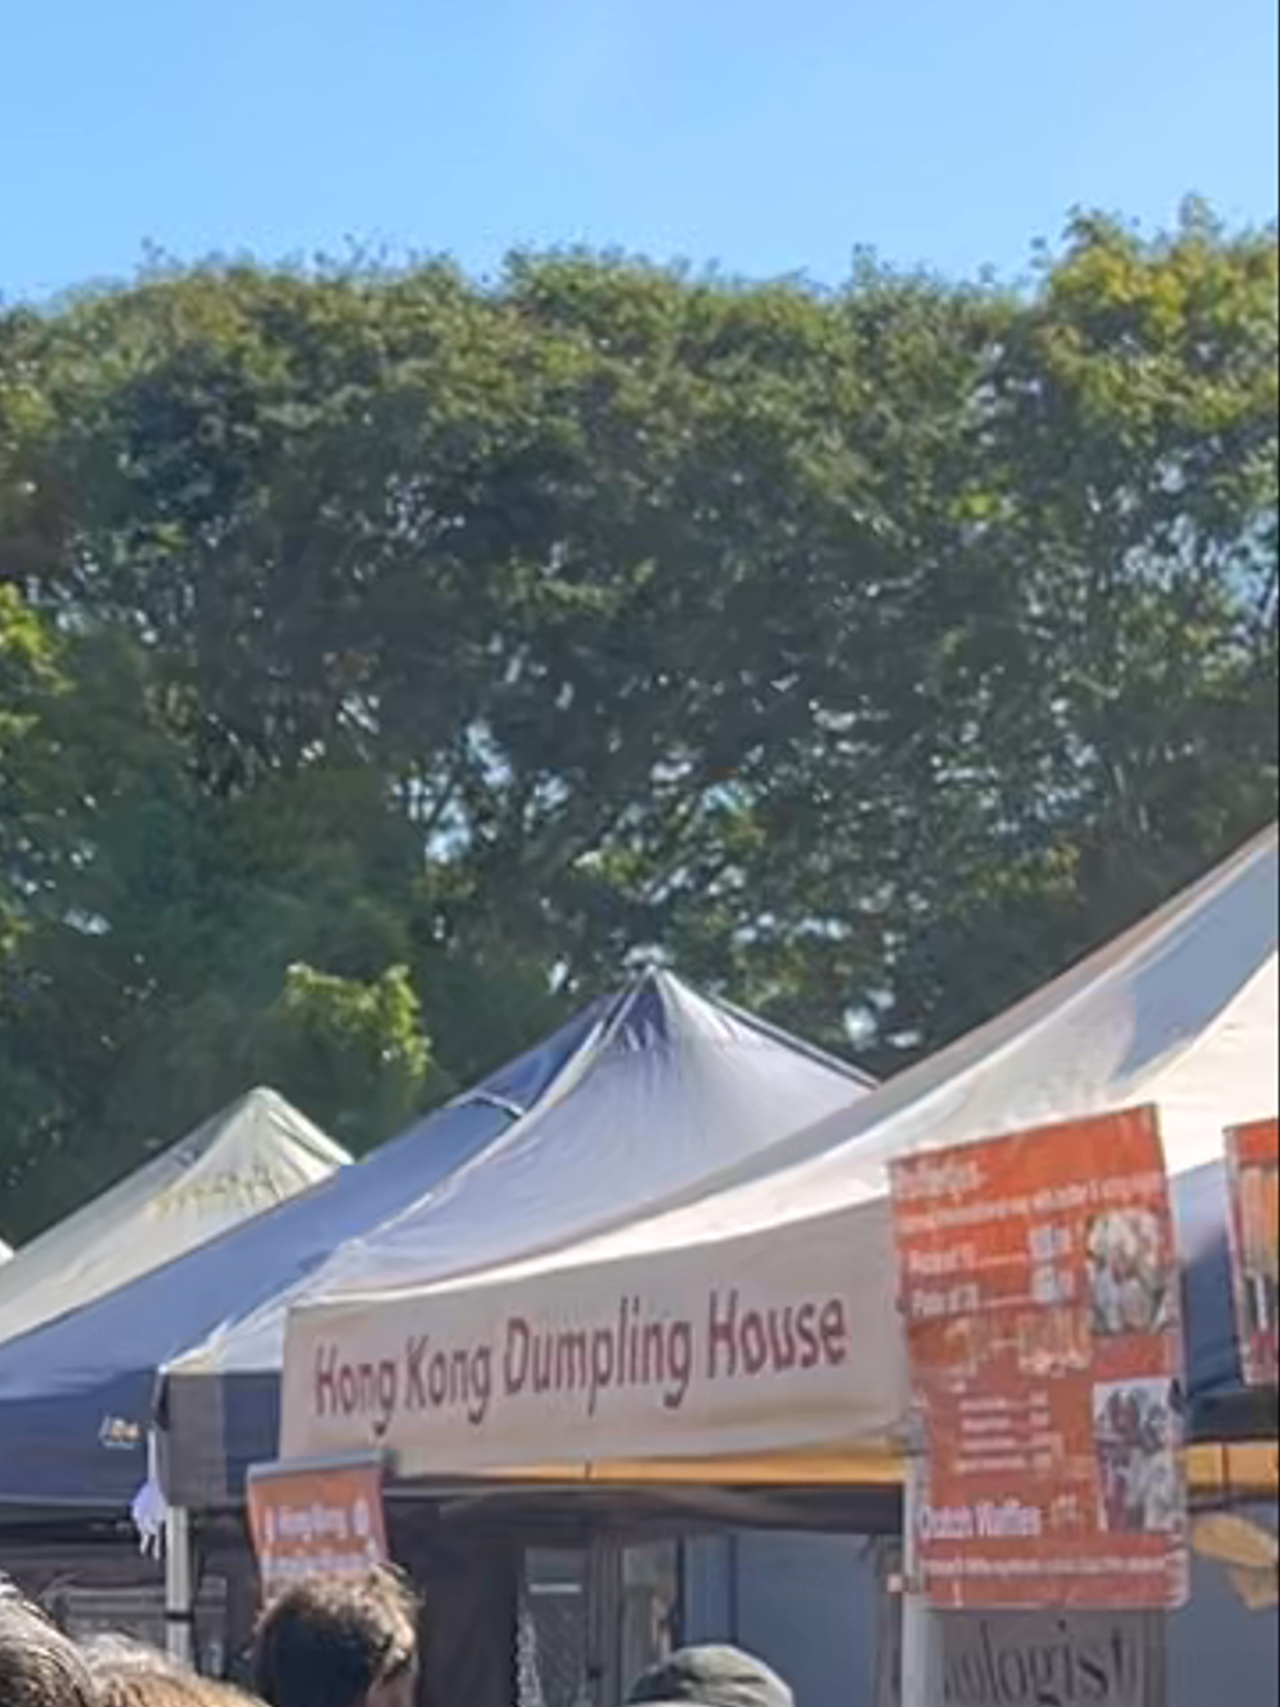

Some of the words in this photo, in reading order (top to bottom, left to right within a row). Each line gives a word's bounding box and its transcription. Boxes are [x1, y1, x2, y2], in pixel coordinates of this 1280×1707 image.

[314, 1344, 395, 1435] Hong
[405, 1334, 492, 1424] Kong
[504, 1296, 691, 1417] Dumpling
[707, 1290, 848, 1379] House
